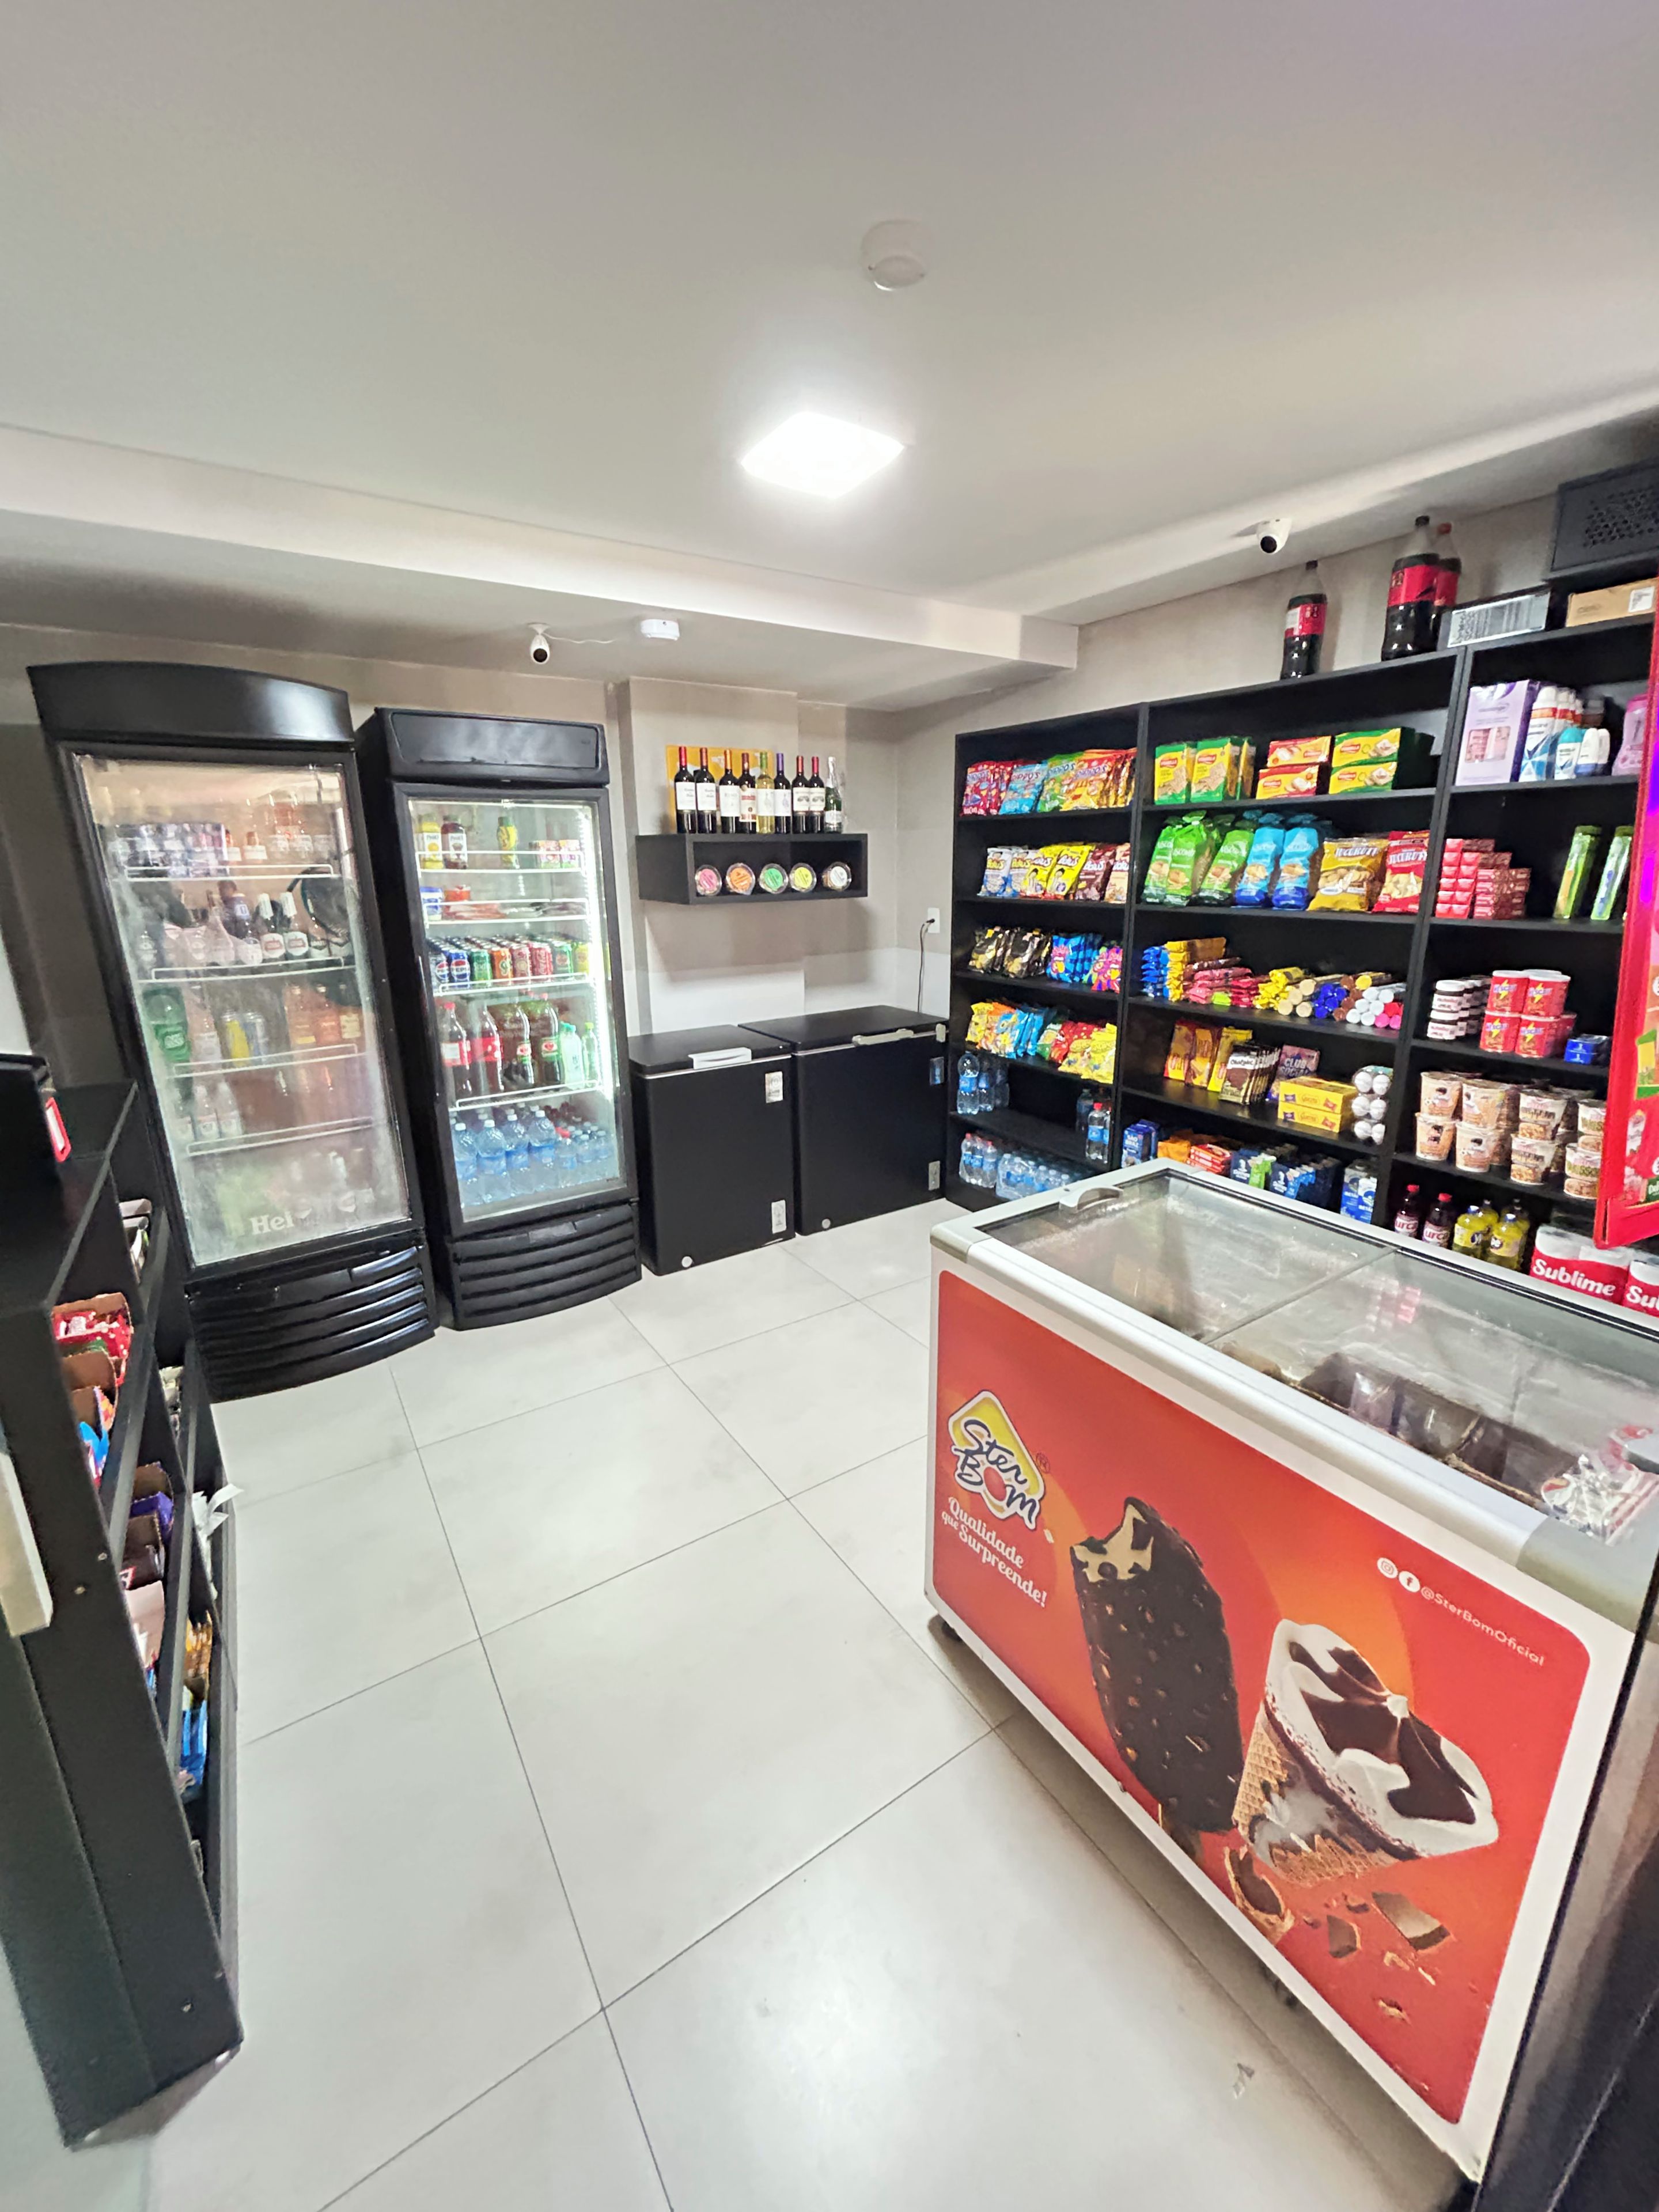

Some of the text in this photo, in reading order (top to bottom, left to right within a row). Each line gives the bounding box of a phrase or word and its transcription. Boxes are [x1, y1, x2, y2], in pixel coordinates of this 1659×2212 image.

[1532, 1258, 1616, 1296] Sublime
[963, 1419, 1028, 1488] Ster
[941, 1510, 1048, 1608] que Surpreende!
[948, 1495, 1025, 1570] Qualidade
[1421, 1586, 1544, 1666] @SterBomOficial
